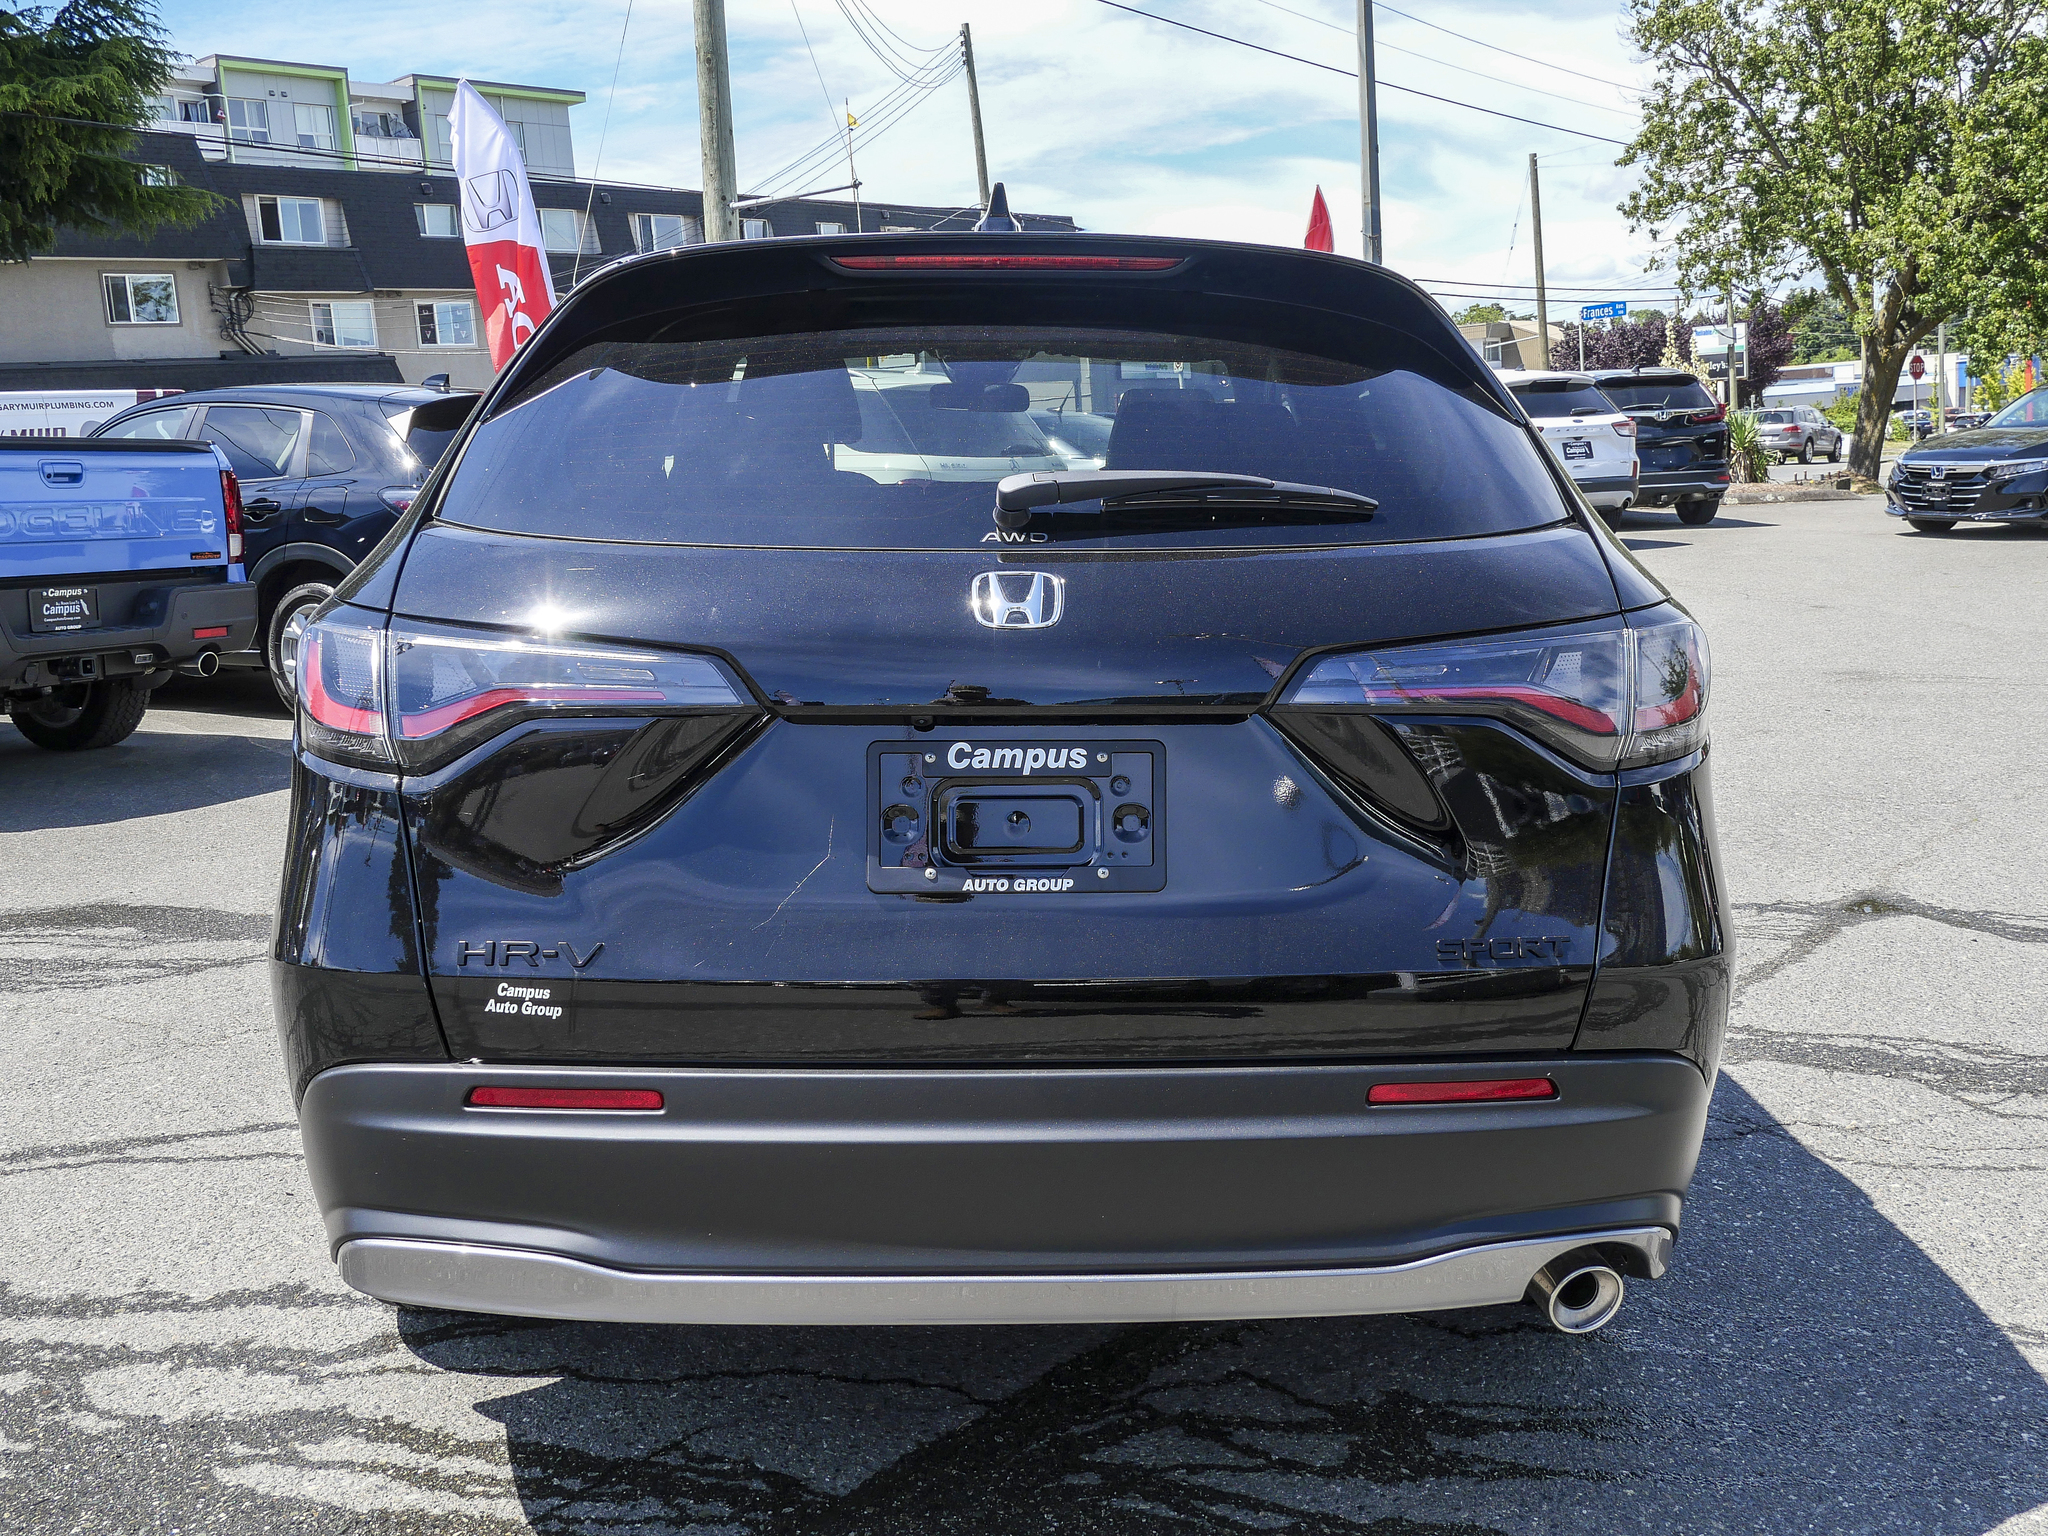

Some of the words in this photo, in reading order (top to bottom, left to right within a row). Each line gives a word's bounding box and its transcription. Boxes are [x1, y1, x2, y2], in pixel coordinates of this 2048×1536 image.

[1583, 307, 1613, 318] Frances
[1910, 363, 1924, 372] STOP
[980, 532, 1049, 543] AWD
[48, 588, 82, 598] Campus
[43, 603, 81, 616] Campus
[947, 741, 1088, 776] Campus
[962, 878, 1009, 892] AUTO
[1013, 878, 1074, 892] GROUP
[456, 940, 605, 968] HR-V
[1435, 935, 1571, 962] SPORT
[497, 982, 551, 1001] Campus
[484, 998, 518, 1014] Auto
[521, 1001, 563, 1020] Group
